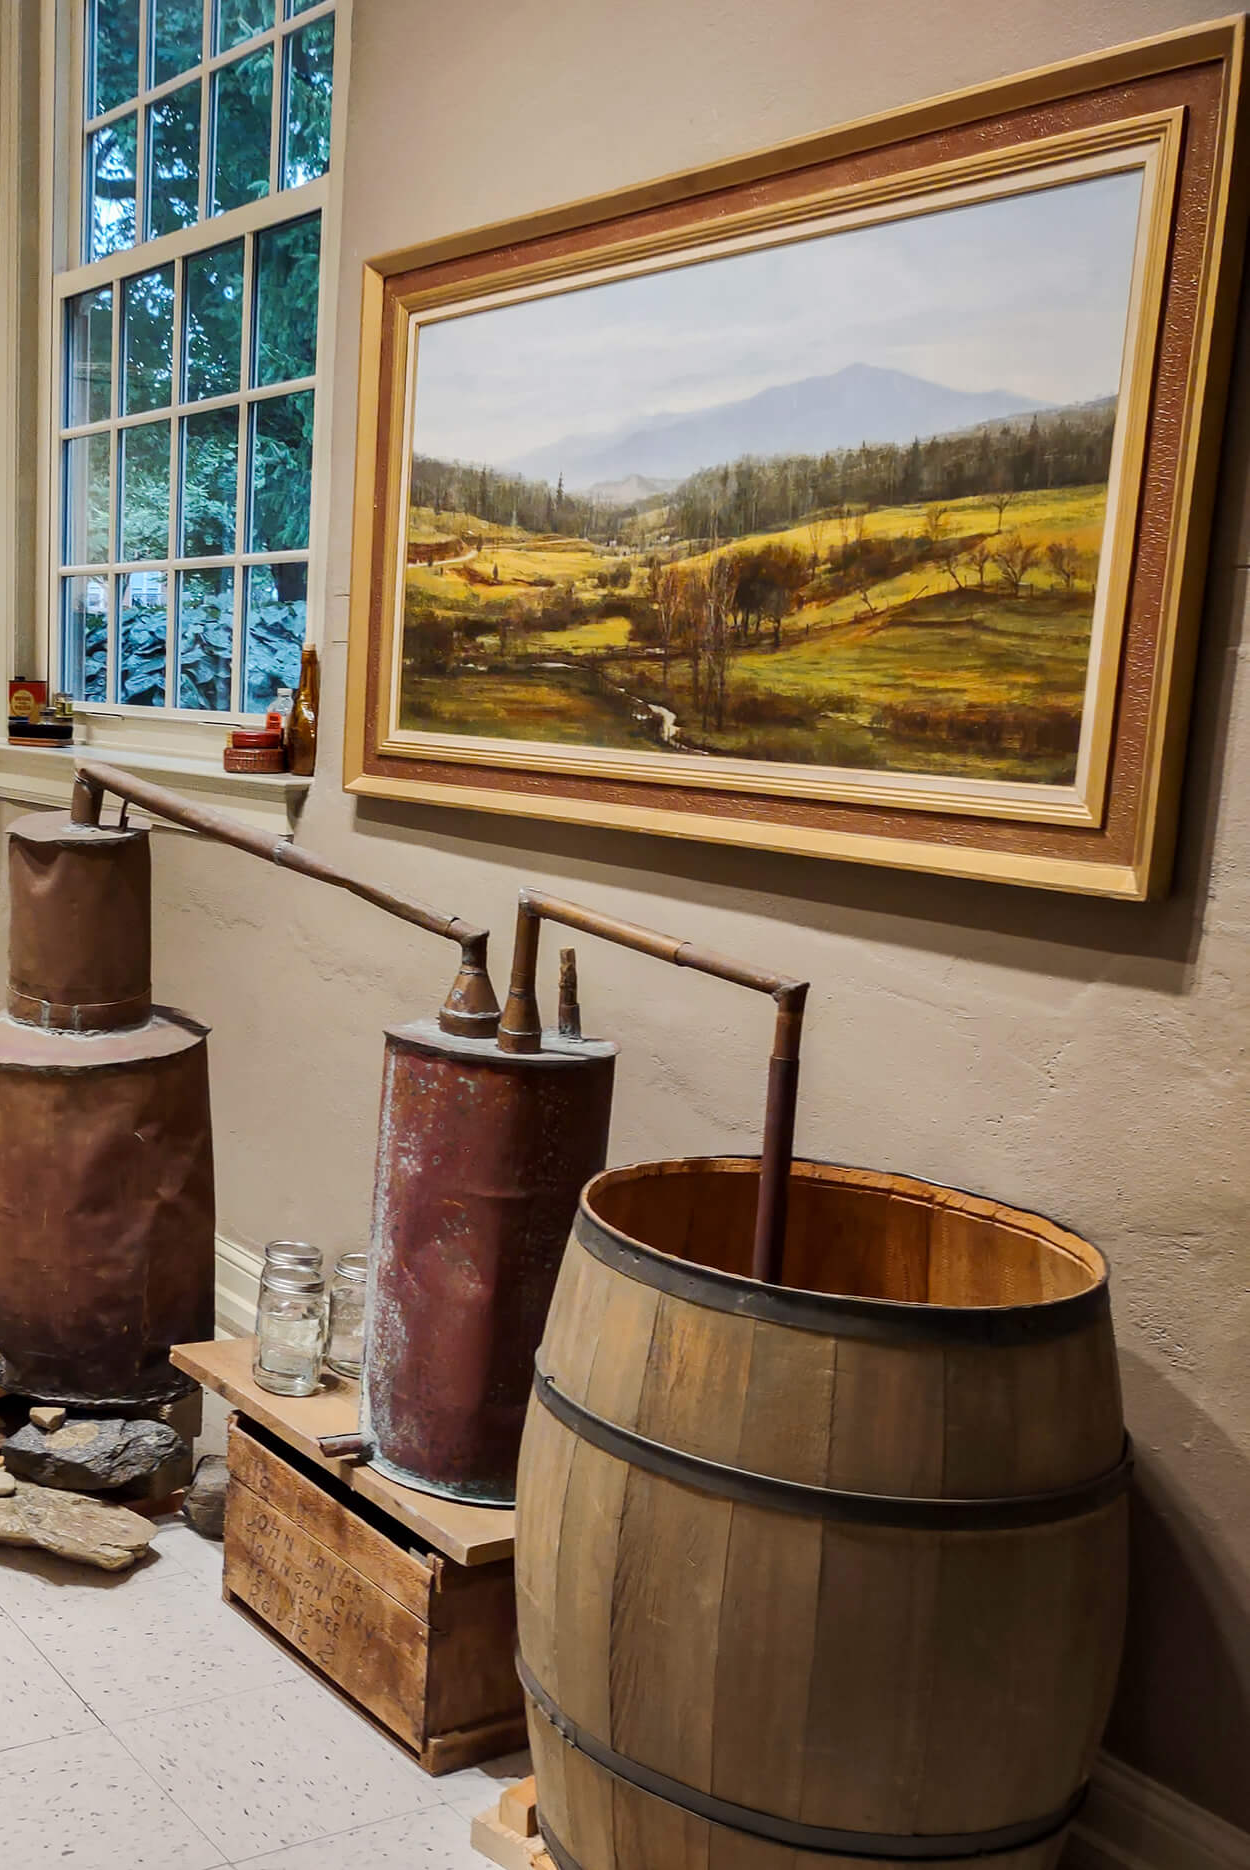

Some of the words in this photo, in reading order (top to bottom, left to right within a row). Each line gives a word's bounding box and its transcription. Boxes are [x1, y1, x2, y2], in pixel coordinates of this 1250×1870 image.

[245, 1513, 295, 1553] JOHN
[246, 1529, 324, 1601] JOHNSON
[247, 1552, 341, 1640] TENNESSEE
[249, 1583, 310, 1645] ROUTE
[316, 1643, 336, 1665] 2
